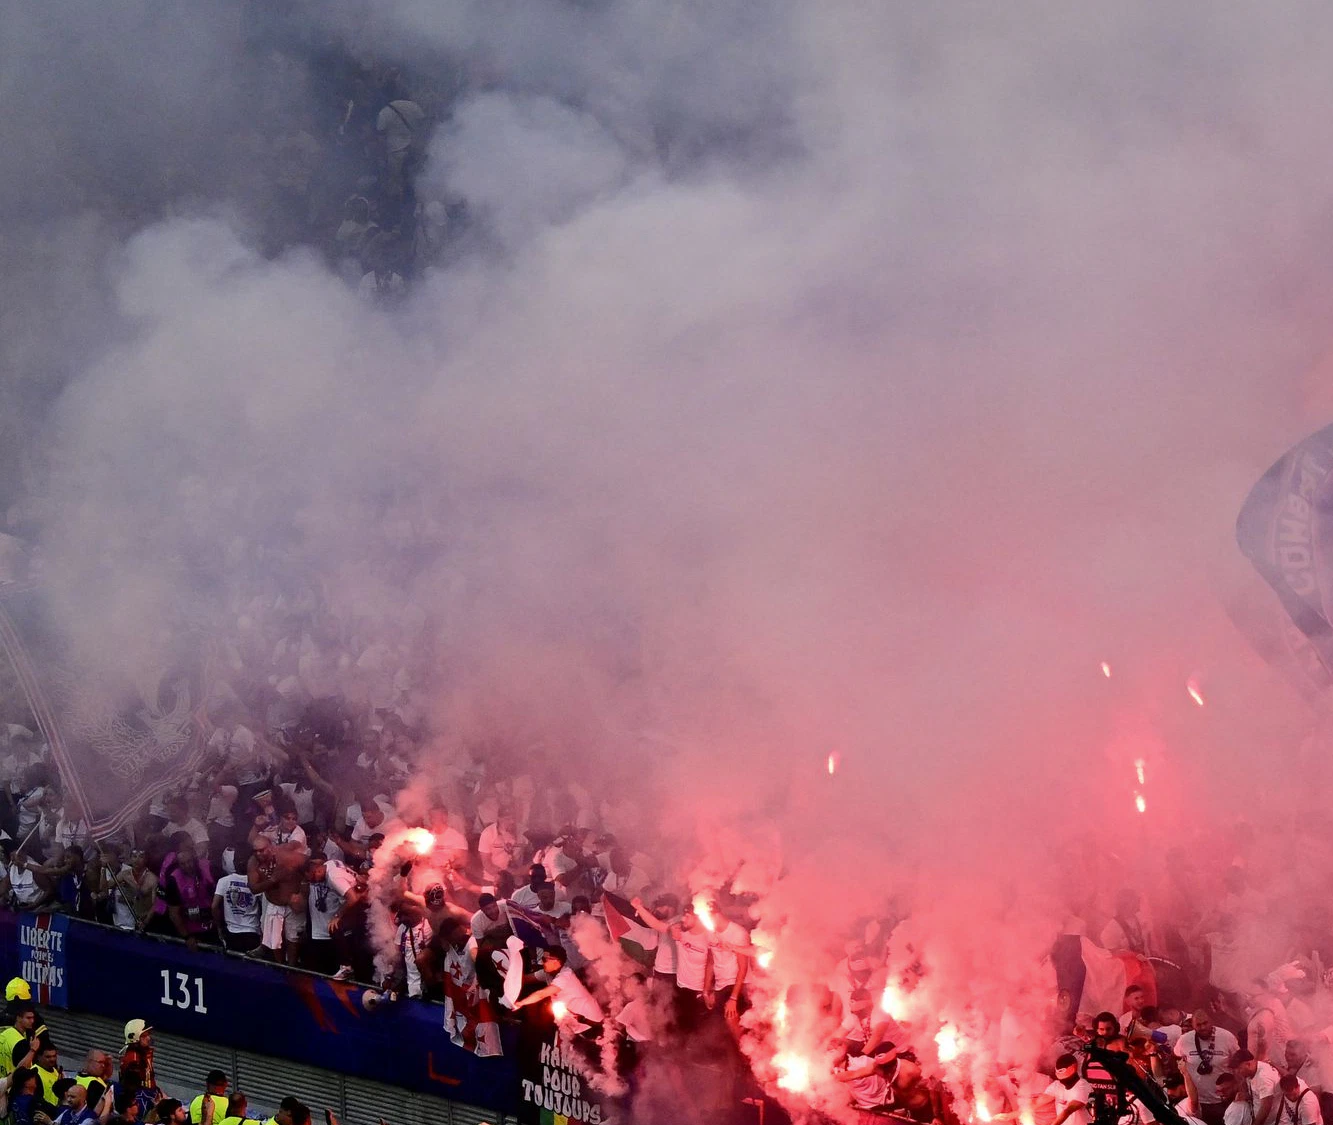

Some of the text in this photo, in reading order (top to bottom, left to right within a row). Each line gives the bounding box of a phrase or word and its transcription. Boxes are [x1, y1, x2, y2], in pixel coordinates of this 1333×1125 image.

[20, 925, 63, 952] LIBERTE
[22, 960, 64, 988] ULTRAS
[160, 969, 208, 1014] 131
[543, 1065, 581, 1098] POUR
[521, 1078, 601, 1125] TOUJOURS
